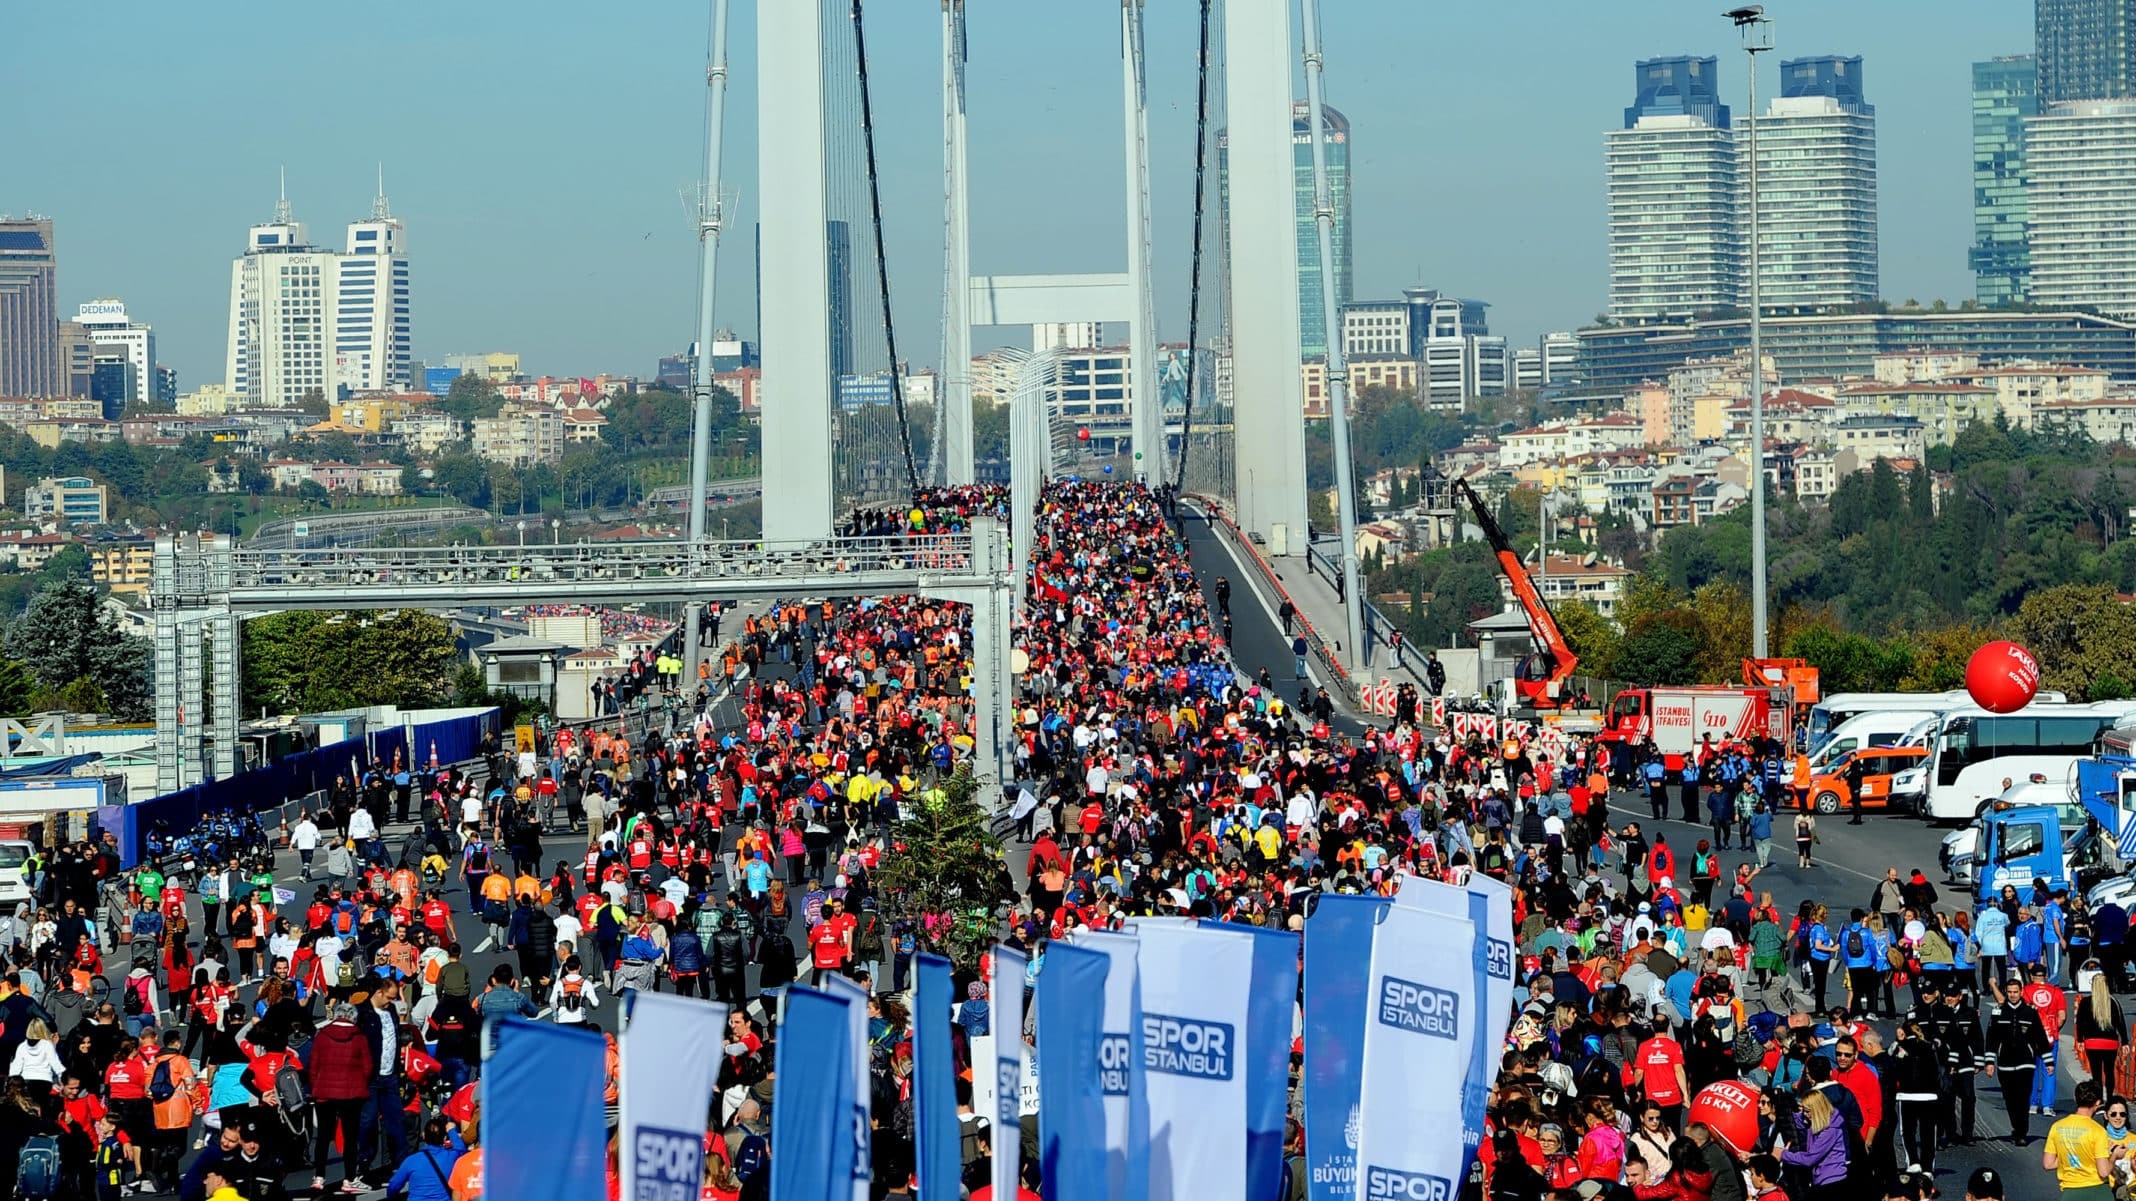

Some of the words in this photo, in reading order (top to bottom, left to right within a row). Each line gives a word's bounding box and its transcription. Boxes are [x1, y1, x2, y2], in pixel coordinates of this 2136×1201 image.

[289, 256, 312, 265] POINT
[81, 305, 122, 314] DEDEMAN
[1656, 706, 1690, 716] İSTANBUL
[1656, 716, 1690, 726] İTFAİYESİ
[1706, 713, 1727, 728] 110
[1487, 940, 1509, 963] OR
[1384, 981, 1454, 1020] SPOR
[1382, 1004, 1455, 1036] İSTANBUL
[1143, 1017, 1227, 1057] SPOR
[1100, 1037, 1130, 1070] OR
[1144, 1046, 1227, 1076] STANBUL
[1712, 1098, 1732, 1112] KM
[638, 1132, 699, 1184] SPOR
[1370, 1170, 1446, 1201] SPOR
